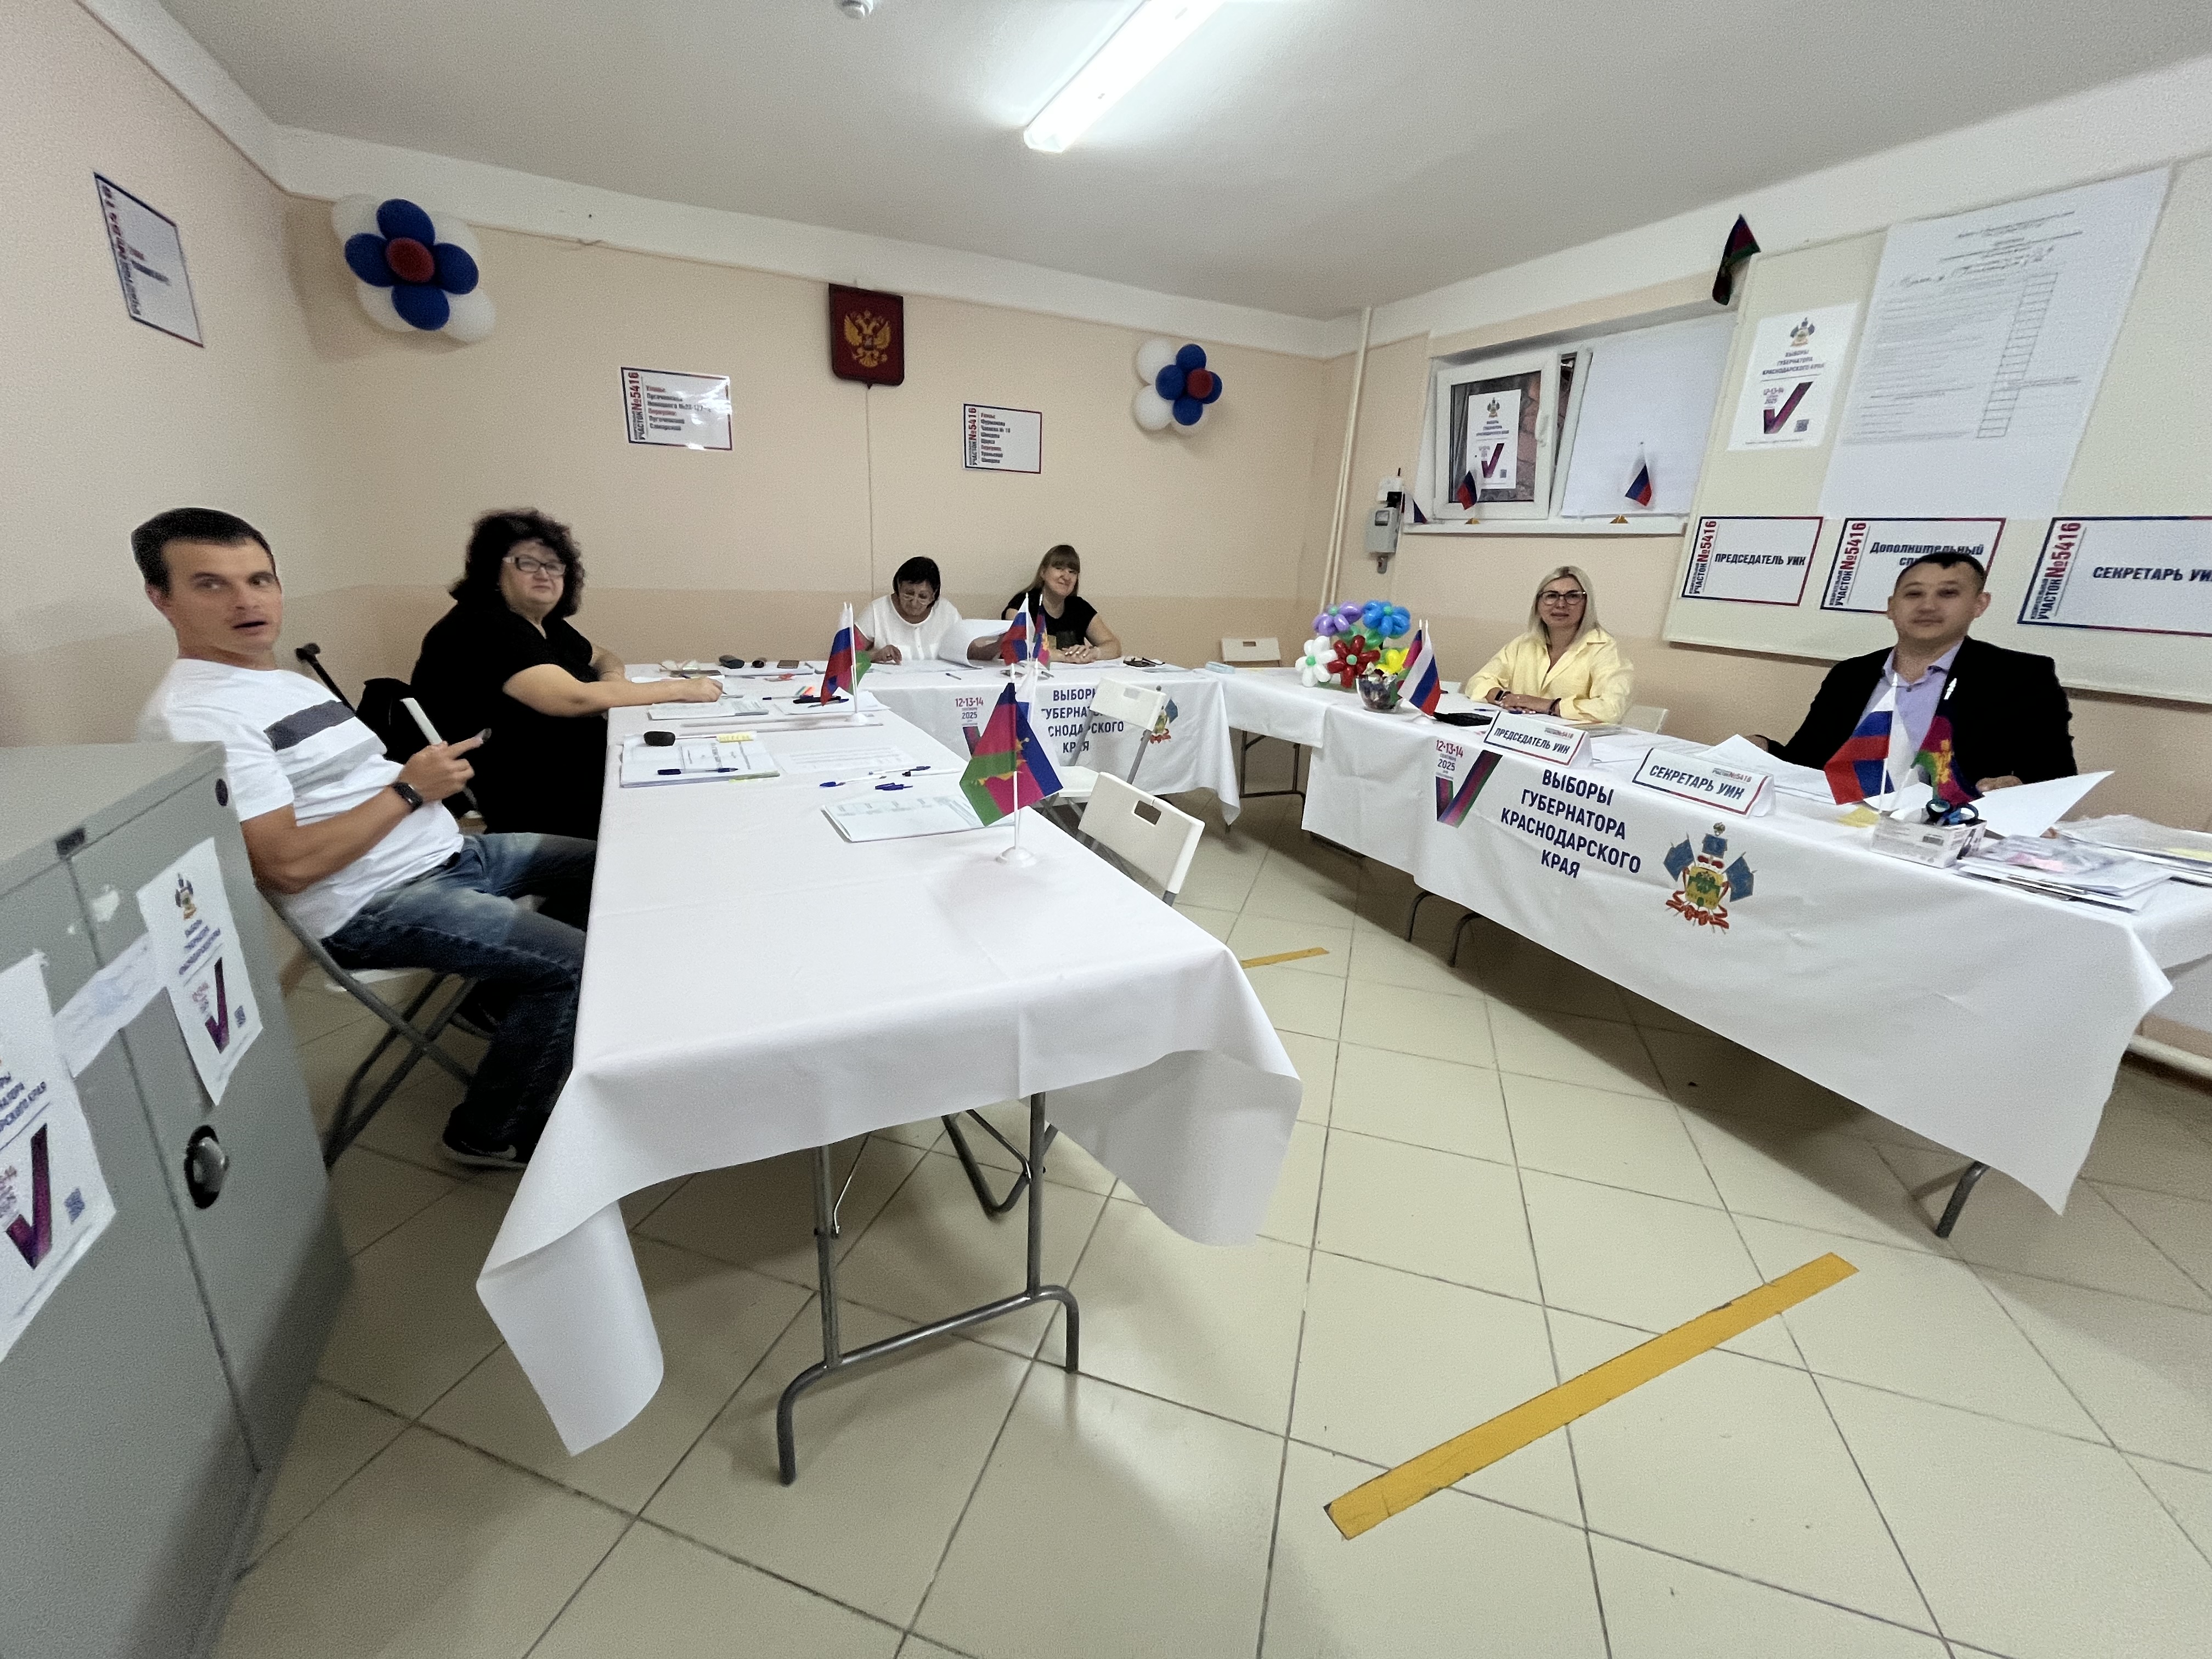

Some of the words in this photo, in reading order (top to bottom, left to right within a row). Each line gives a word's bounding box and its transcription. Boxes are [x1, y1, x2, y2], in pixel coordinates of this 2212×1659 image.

[628, 372, 642, 411] №5416
[1697, 521, 1717, 562] №5416
[1839, 522, 1866, 570] №5416
[1870, 542, 1984, 556] Дополнительный
[2045, 522, 2081, 578] №5416
[1714, 553, 1784, 565] ПРЕДСЕДАТЕЛЬ
[2092, 567, 2183, 581] СЕКРЕТАРЬ
[2188, 569, 2212, 582] УИ
[1694, 563, 1707, 595] УЧАСТОК
[1835, 571, 1853, 606] УЧАСТОК
[2037, 579, 2062, 620] УЧАСТОК
[1063, 741, 1090, 753] КРЯ
[1494, 727, 1551, 749] ПРЕДСЕДАТЕЛЬ
[1437, 758, 1455, 771] 2025
[1649, 765, 1714, 792] СЕКРЕТАРЬ
[1542, 769, 1614, 806] ВЫБОРЫ
[1521, 788, 1626, 840] ГУБЕРНАТОРА
[1500, 808, 1641, 873] КРАСНОДАРСКОГО
[1541, 849, 1580, 878] КРАЯ
